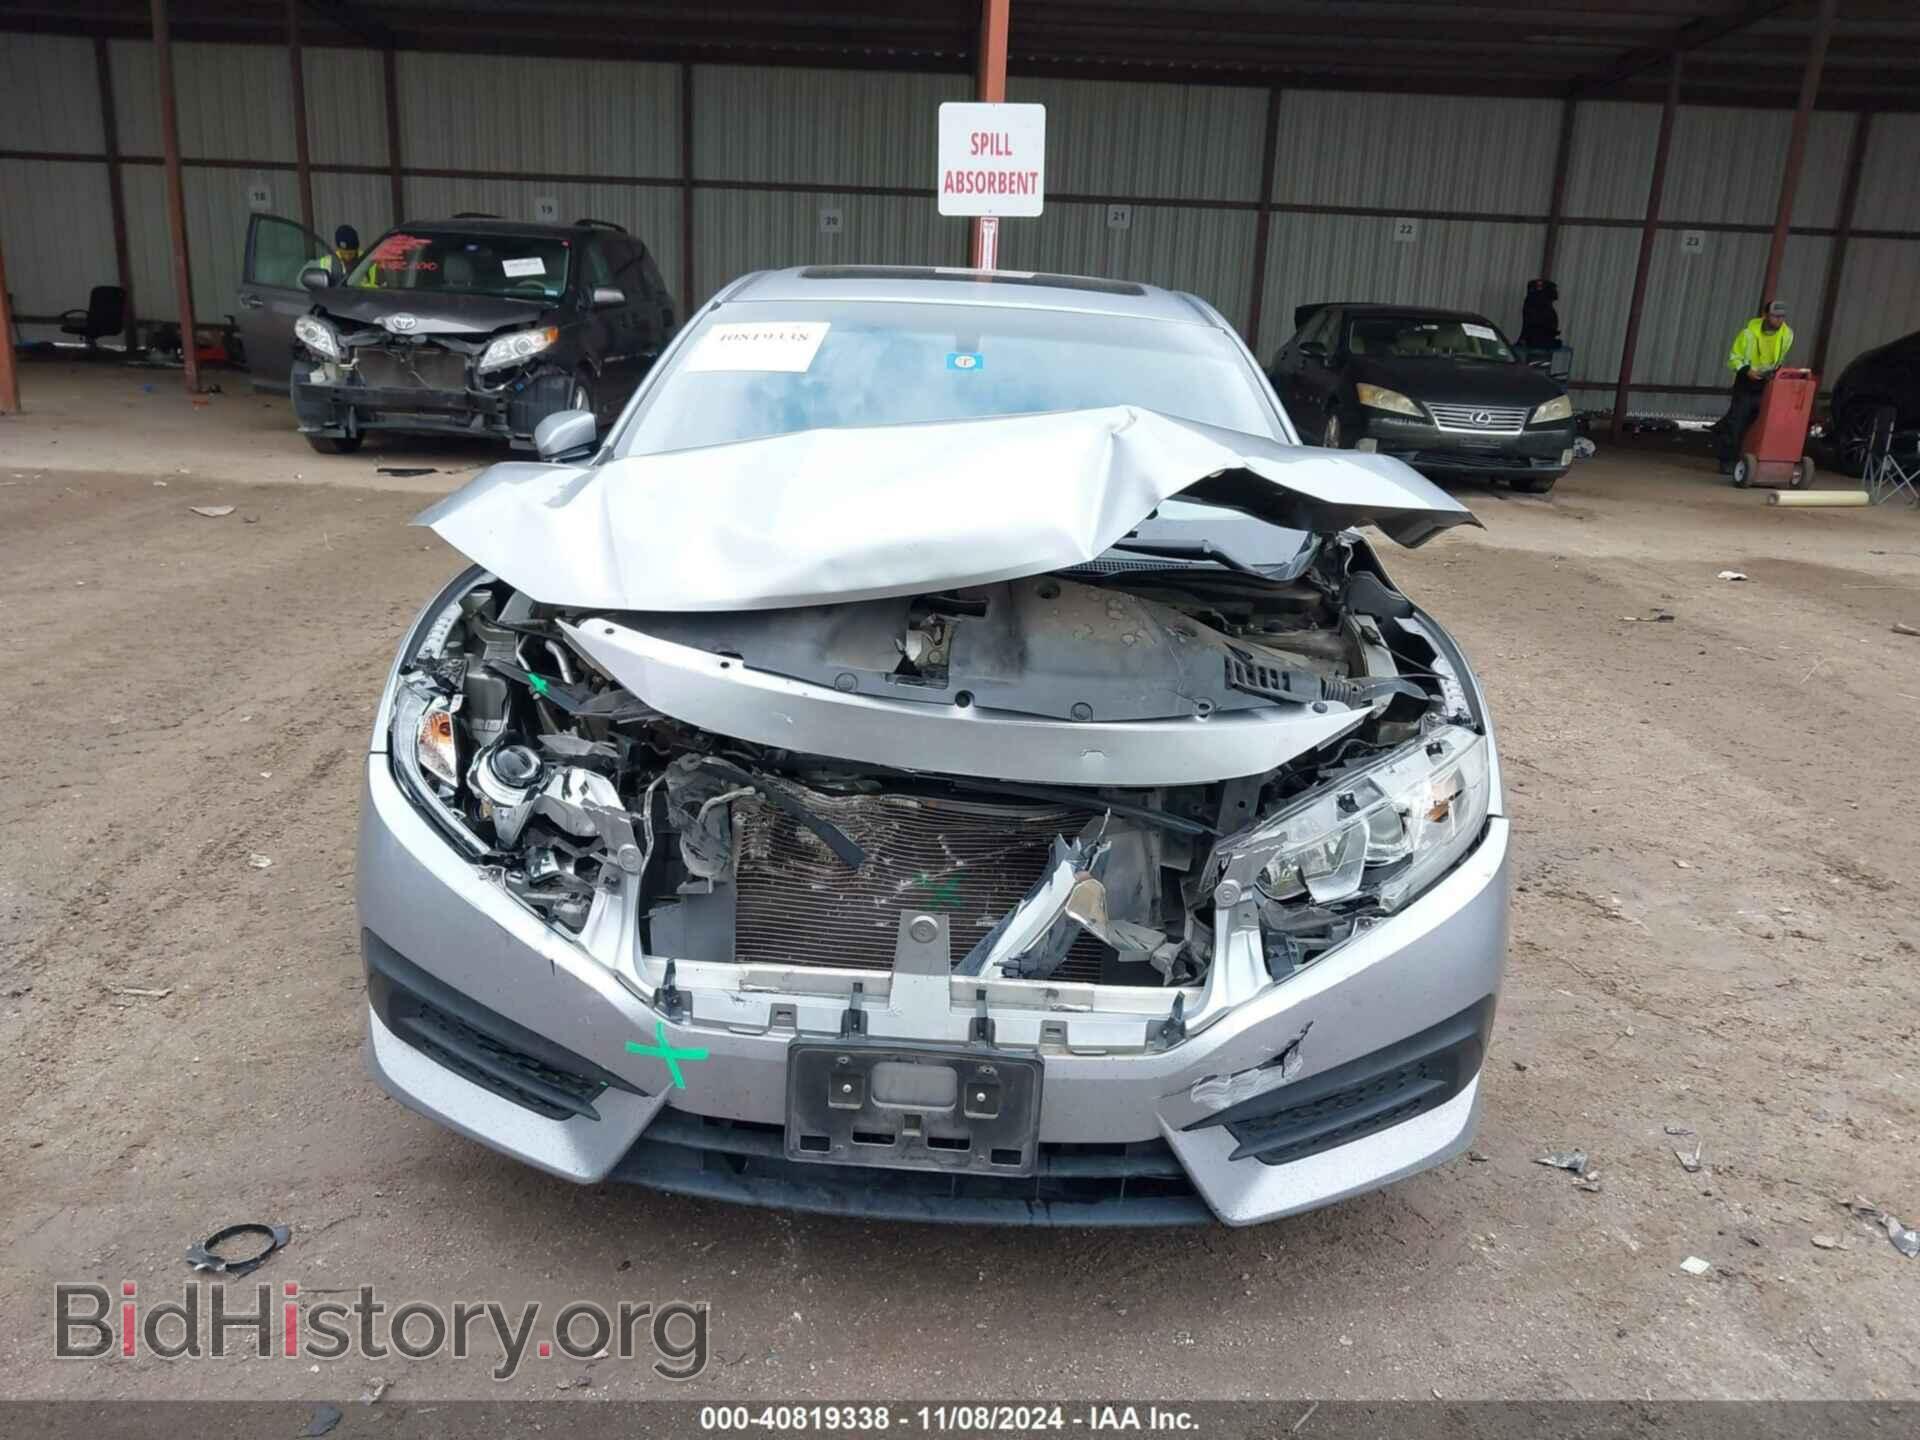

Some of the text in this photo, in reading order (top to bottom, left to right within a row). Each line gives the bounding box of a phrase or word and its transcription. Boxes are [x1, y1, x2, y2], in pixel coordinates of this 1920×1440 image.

[970, 132, 1013, 156] SPILL
[944, 171, 1039, 195] ABSORBENT
[1113, 212, 1125, 222] 21
[1399, 224, 1412, 234] 22
[1686, 237, 1699, 247] 23
